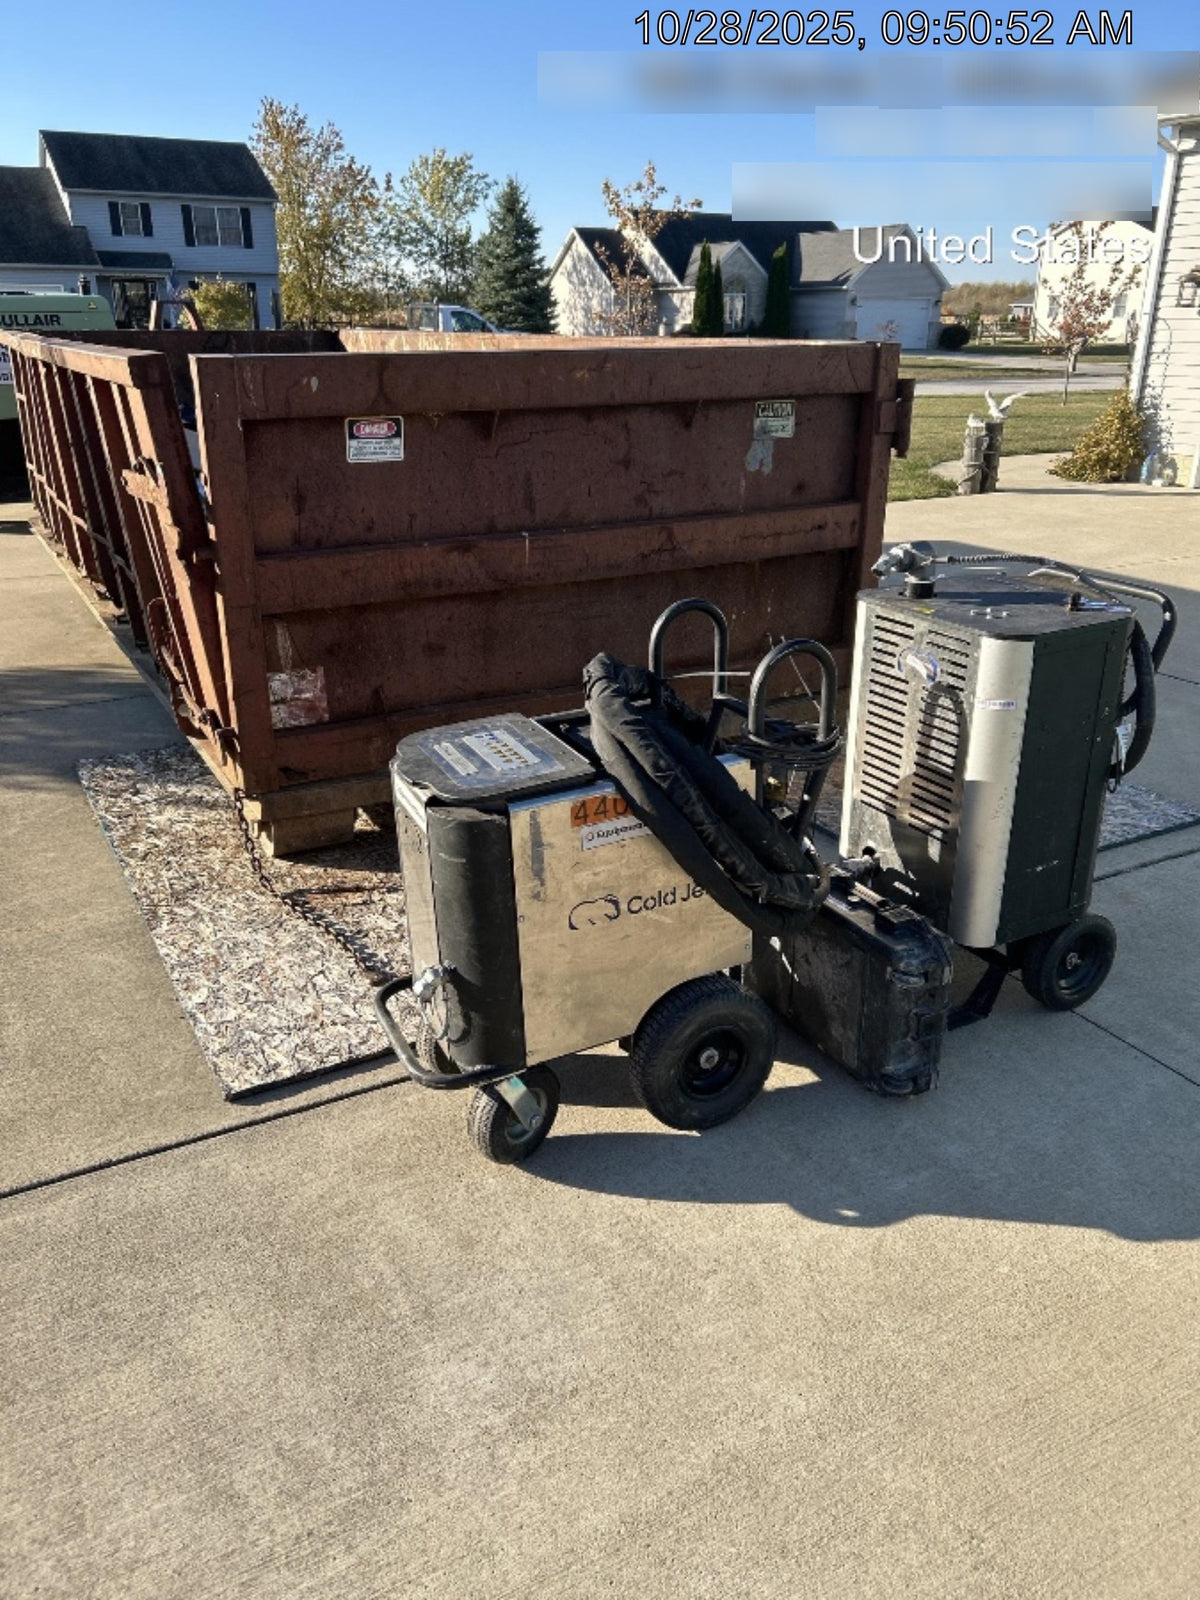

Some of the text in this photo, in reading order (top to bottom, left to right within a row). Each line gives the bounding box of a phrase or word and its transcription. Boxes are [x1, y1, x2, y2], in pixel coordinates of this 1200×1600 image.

[0, 314, 62, 327] ULLAIR
[627, 883, 709, 915] Cold Je
